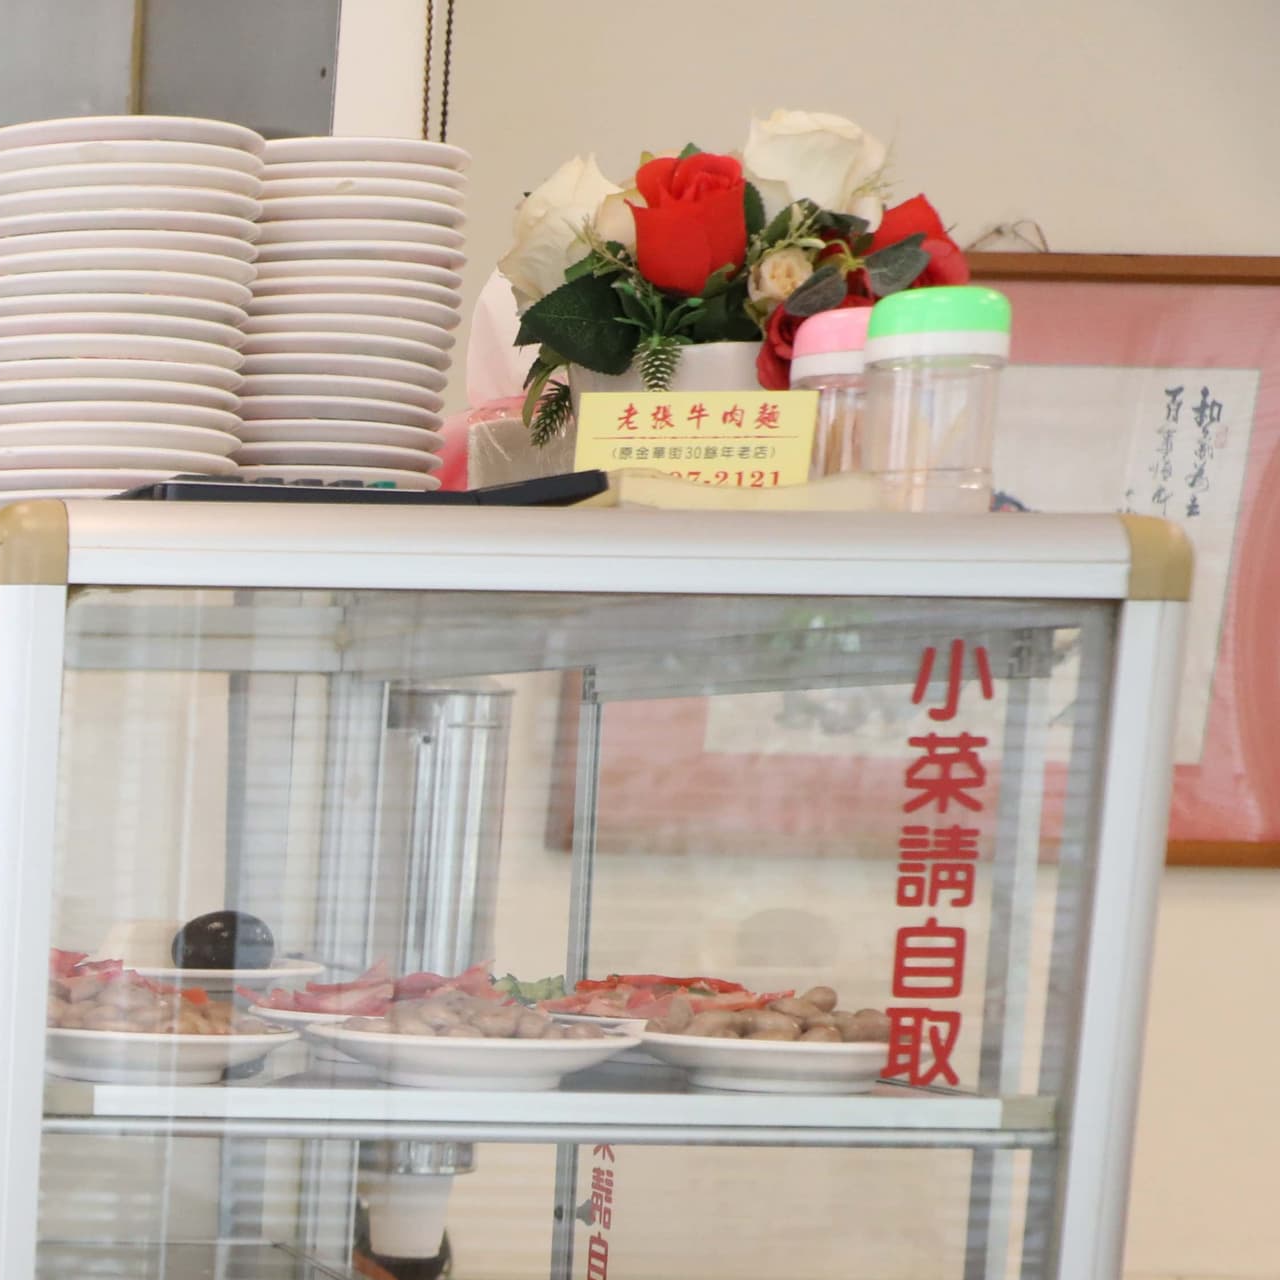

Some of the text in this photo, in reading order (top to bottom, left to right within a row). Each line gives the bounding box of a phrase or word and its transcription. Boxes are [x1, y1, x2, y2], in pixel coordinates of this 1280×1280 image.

[616, 402, 781, 431] 老張牛肉麵
[880, 638, 994, 1088] 小菜請自取
